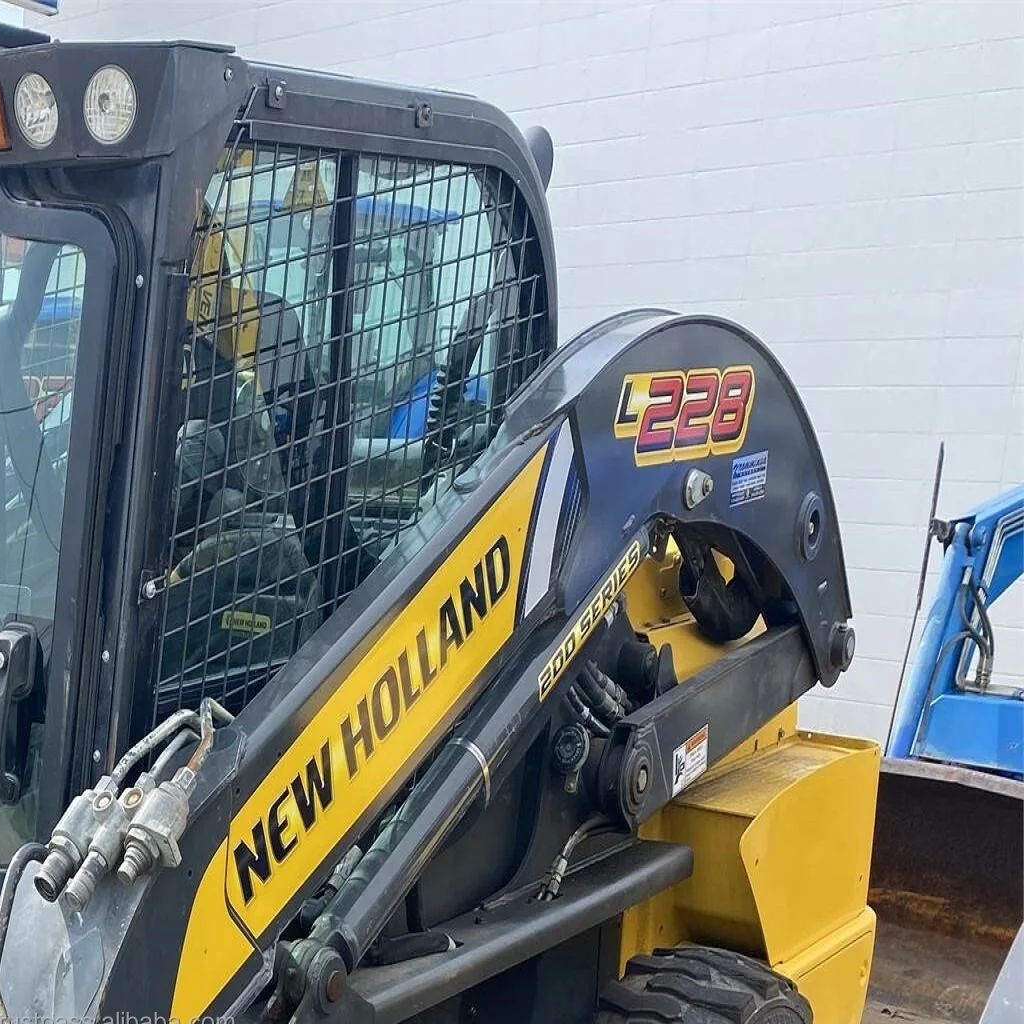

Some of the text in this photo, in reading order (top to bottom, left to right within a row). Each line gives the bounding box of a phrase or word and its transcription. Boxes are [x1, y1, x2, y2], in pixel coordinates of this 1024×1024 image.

[615, 366, 754, 464] L228
[540, 548, 639, 694] 200 SERIES
[233, 534, 511, 905] NEW HOLLAND
